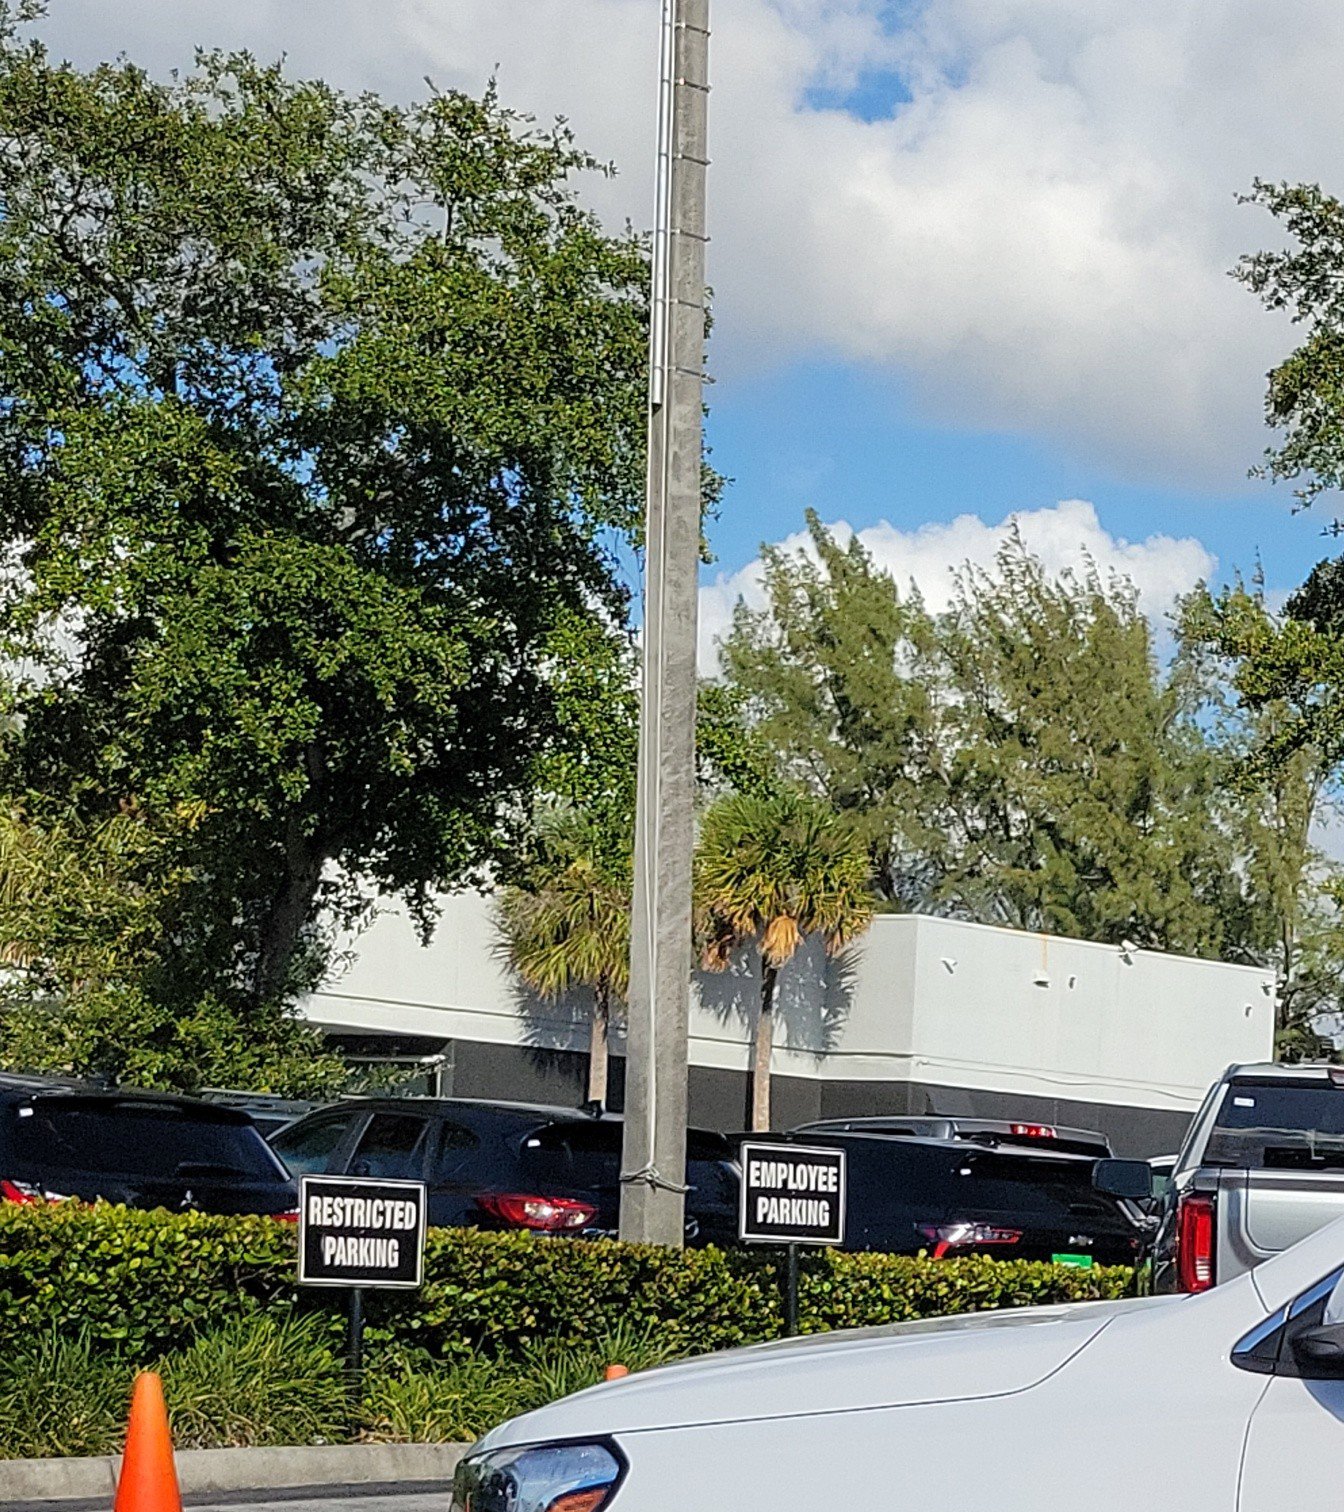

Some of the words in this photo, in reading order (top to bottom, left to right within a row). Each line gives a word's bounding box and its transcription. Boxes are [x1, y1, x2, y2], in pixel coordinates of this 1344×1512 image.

[749, 1160, 838, 1193] EMPLOYEE
[308, 1195, 417, 1230] RESTRICTED
[756, 1196, 830, 1227] PARKING
[323, 1235, 399, 1268] PARKING
